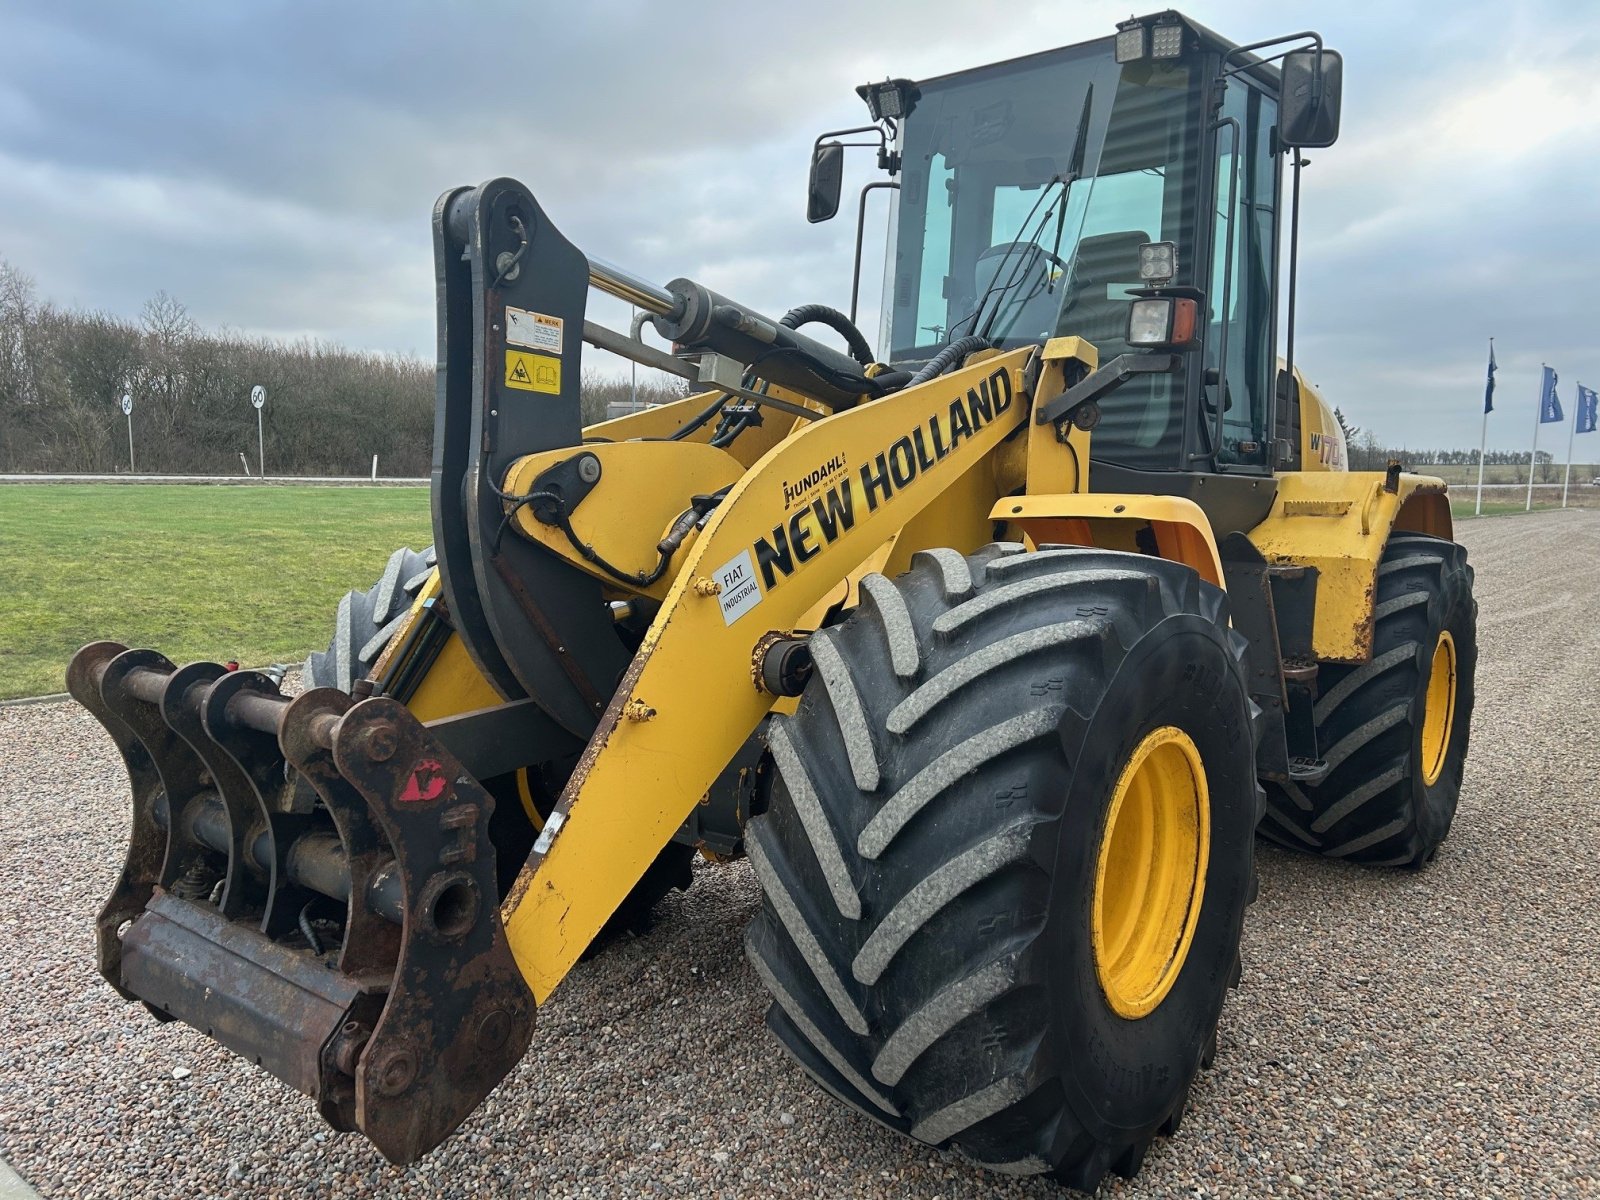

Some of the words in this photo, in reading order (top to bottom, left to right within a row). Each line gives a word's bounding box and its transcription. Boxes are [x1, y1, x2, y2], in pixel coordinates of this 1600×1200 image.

[253, 391, 263, 402] 60
[753, 476, 855, 592] NEW
[859, 366, 1012, 513] HOLLAND
[783, 456, 842, 510] HUNDAHL
[723, 564, 744, 588] FIAT
[723, 581, 758, 612] INDUSTRIAL
